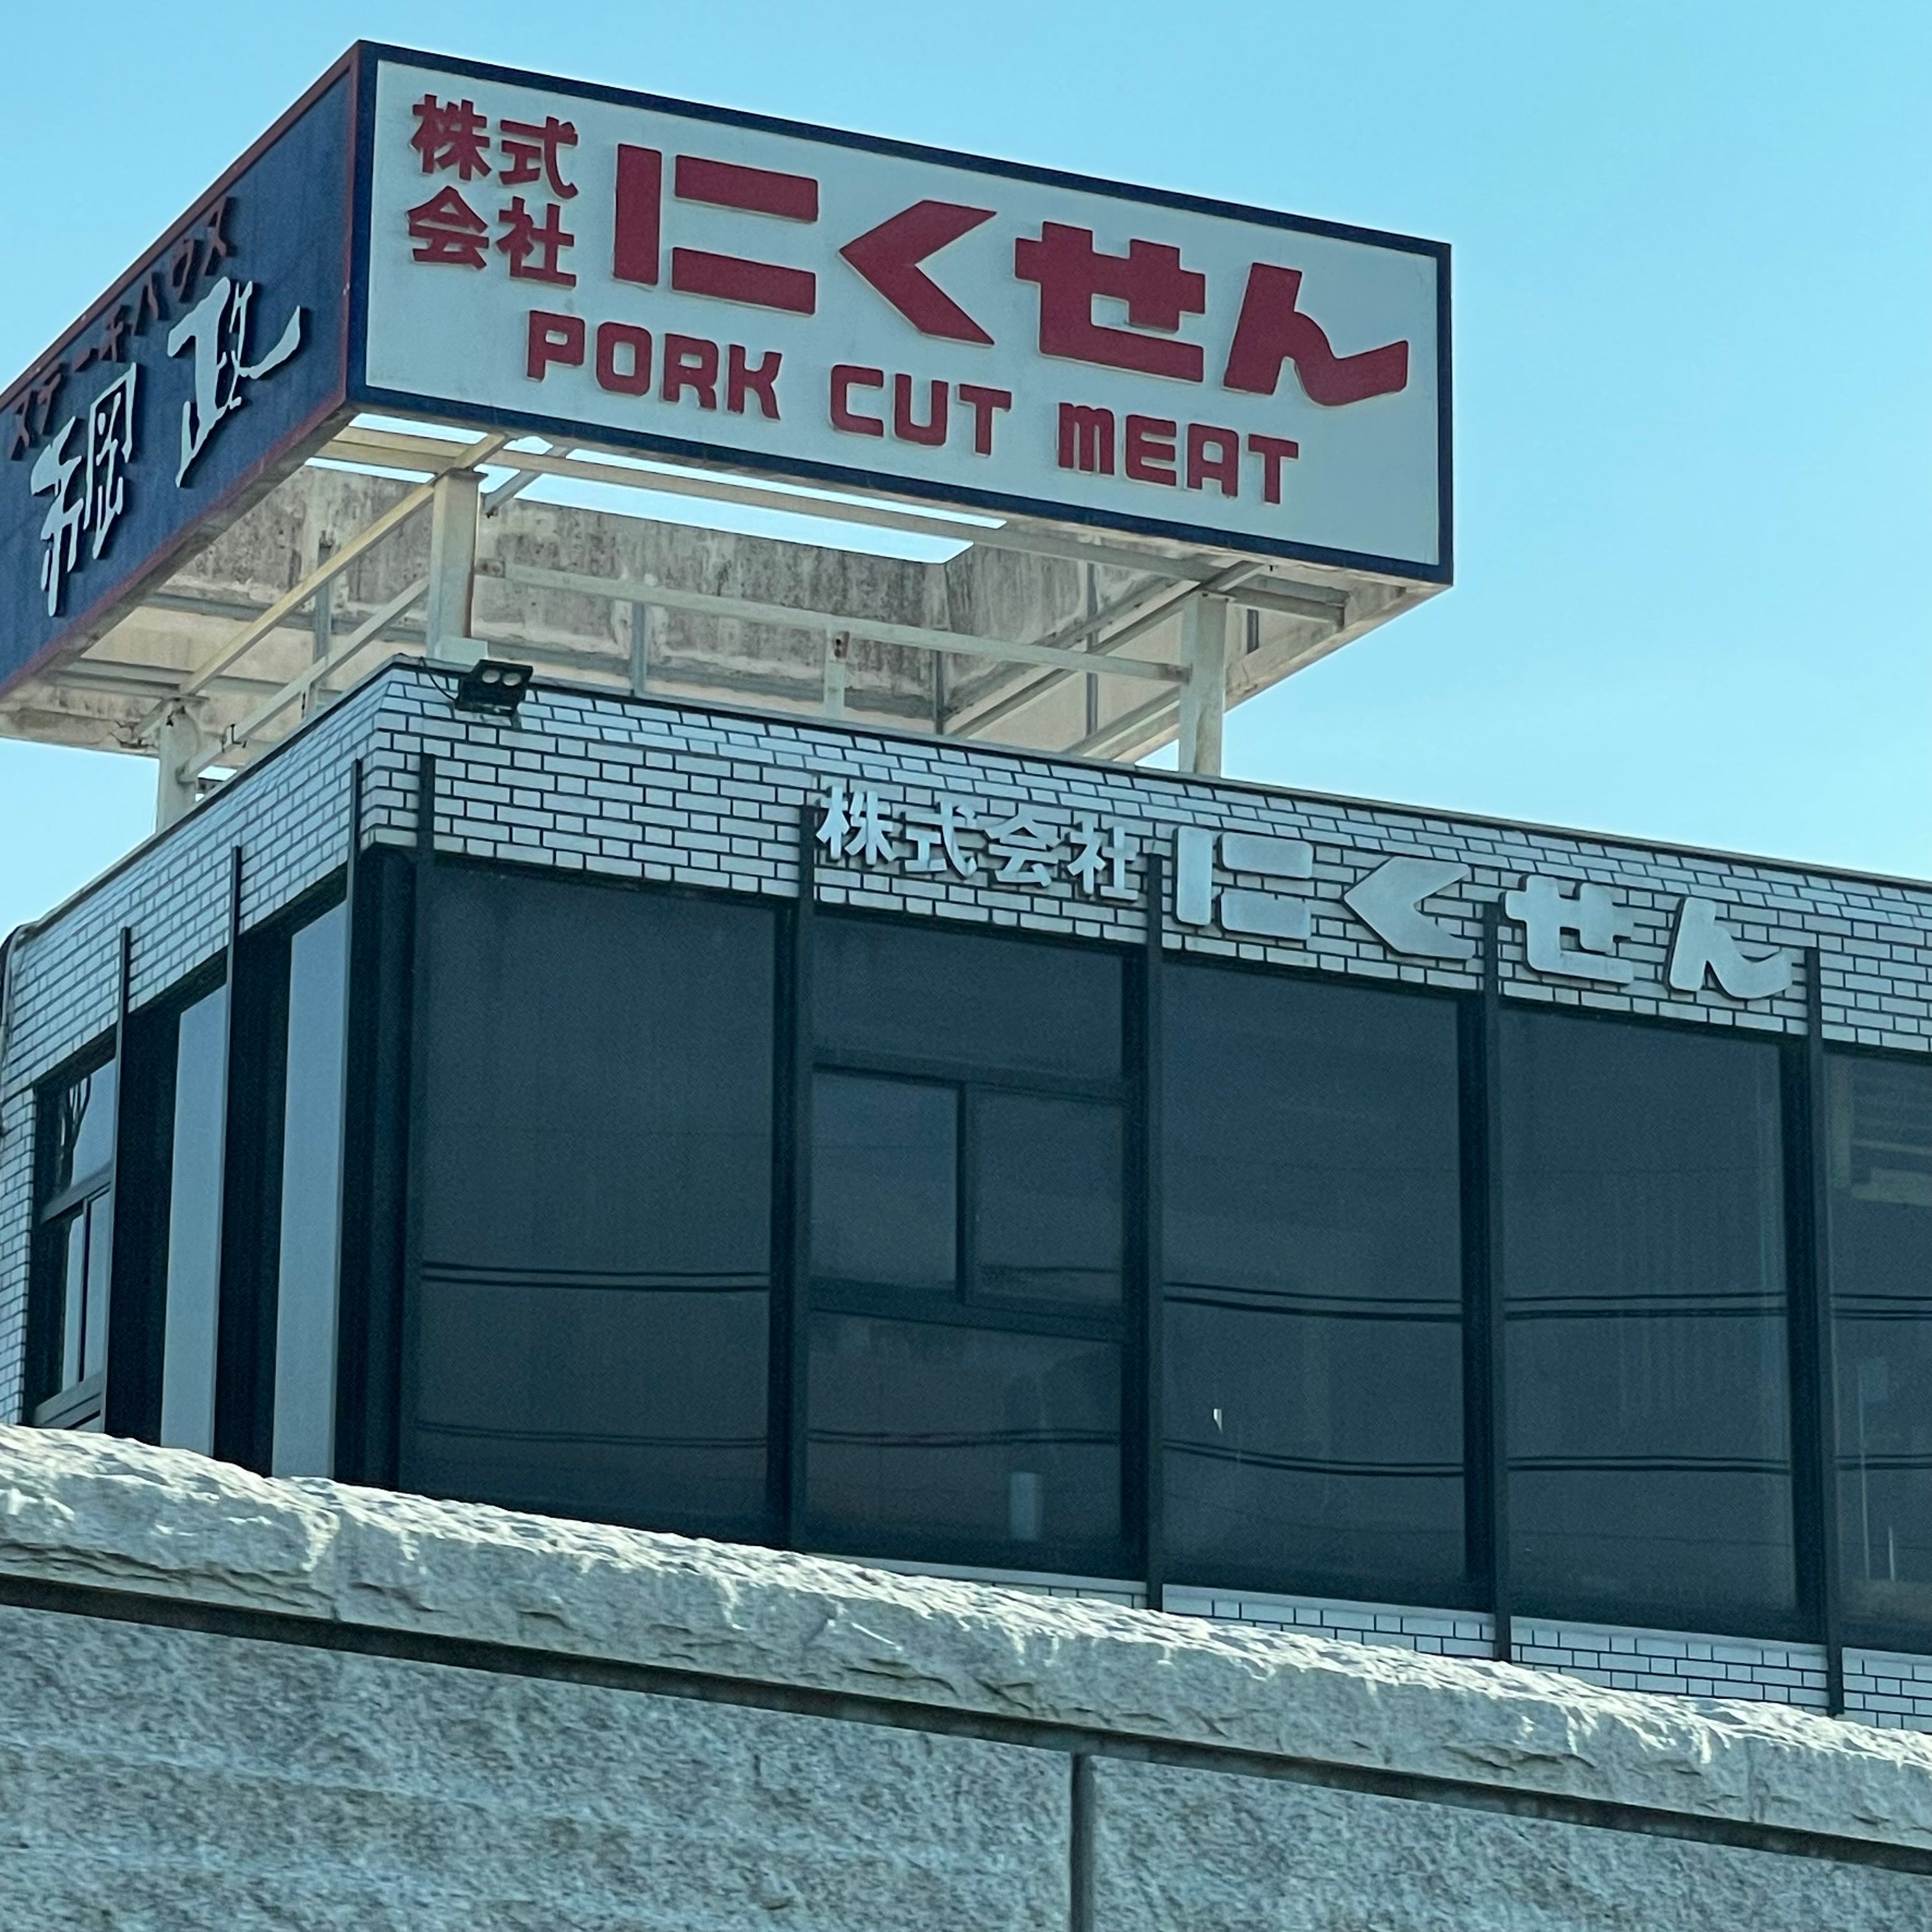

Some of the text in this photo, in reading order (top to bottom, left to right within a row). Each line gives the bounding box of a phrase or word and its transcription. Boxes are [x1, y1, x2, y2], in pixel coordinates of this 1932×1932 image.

[408, 186, 577, 286] 会社
[412, 94, 578, 198] 株式
[8, 196, 227, 461] ステーキハウス
[614, 144, 1408, 405] にくせん
[528, 310, 1298, 503] PORK CUT MEAT
